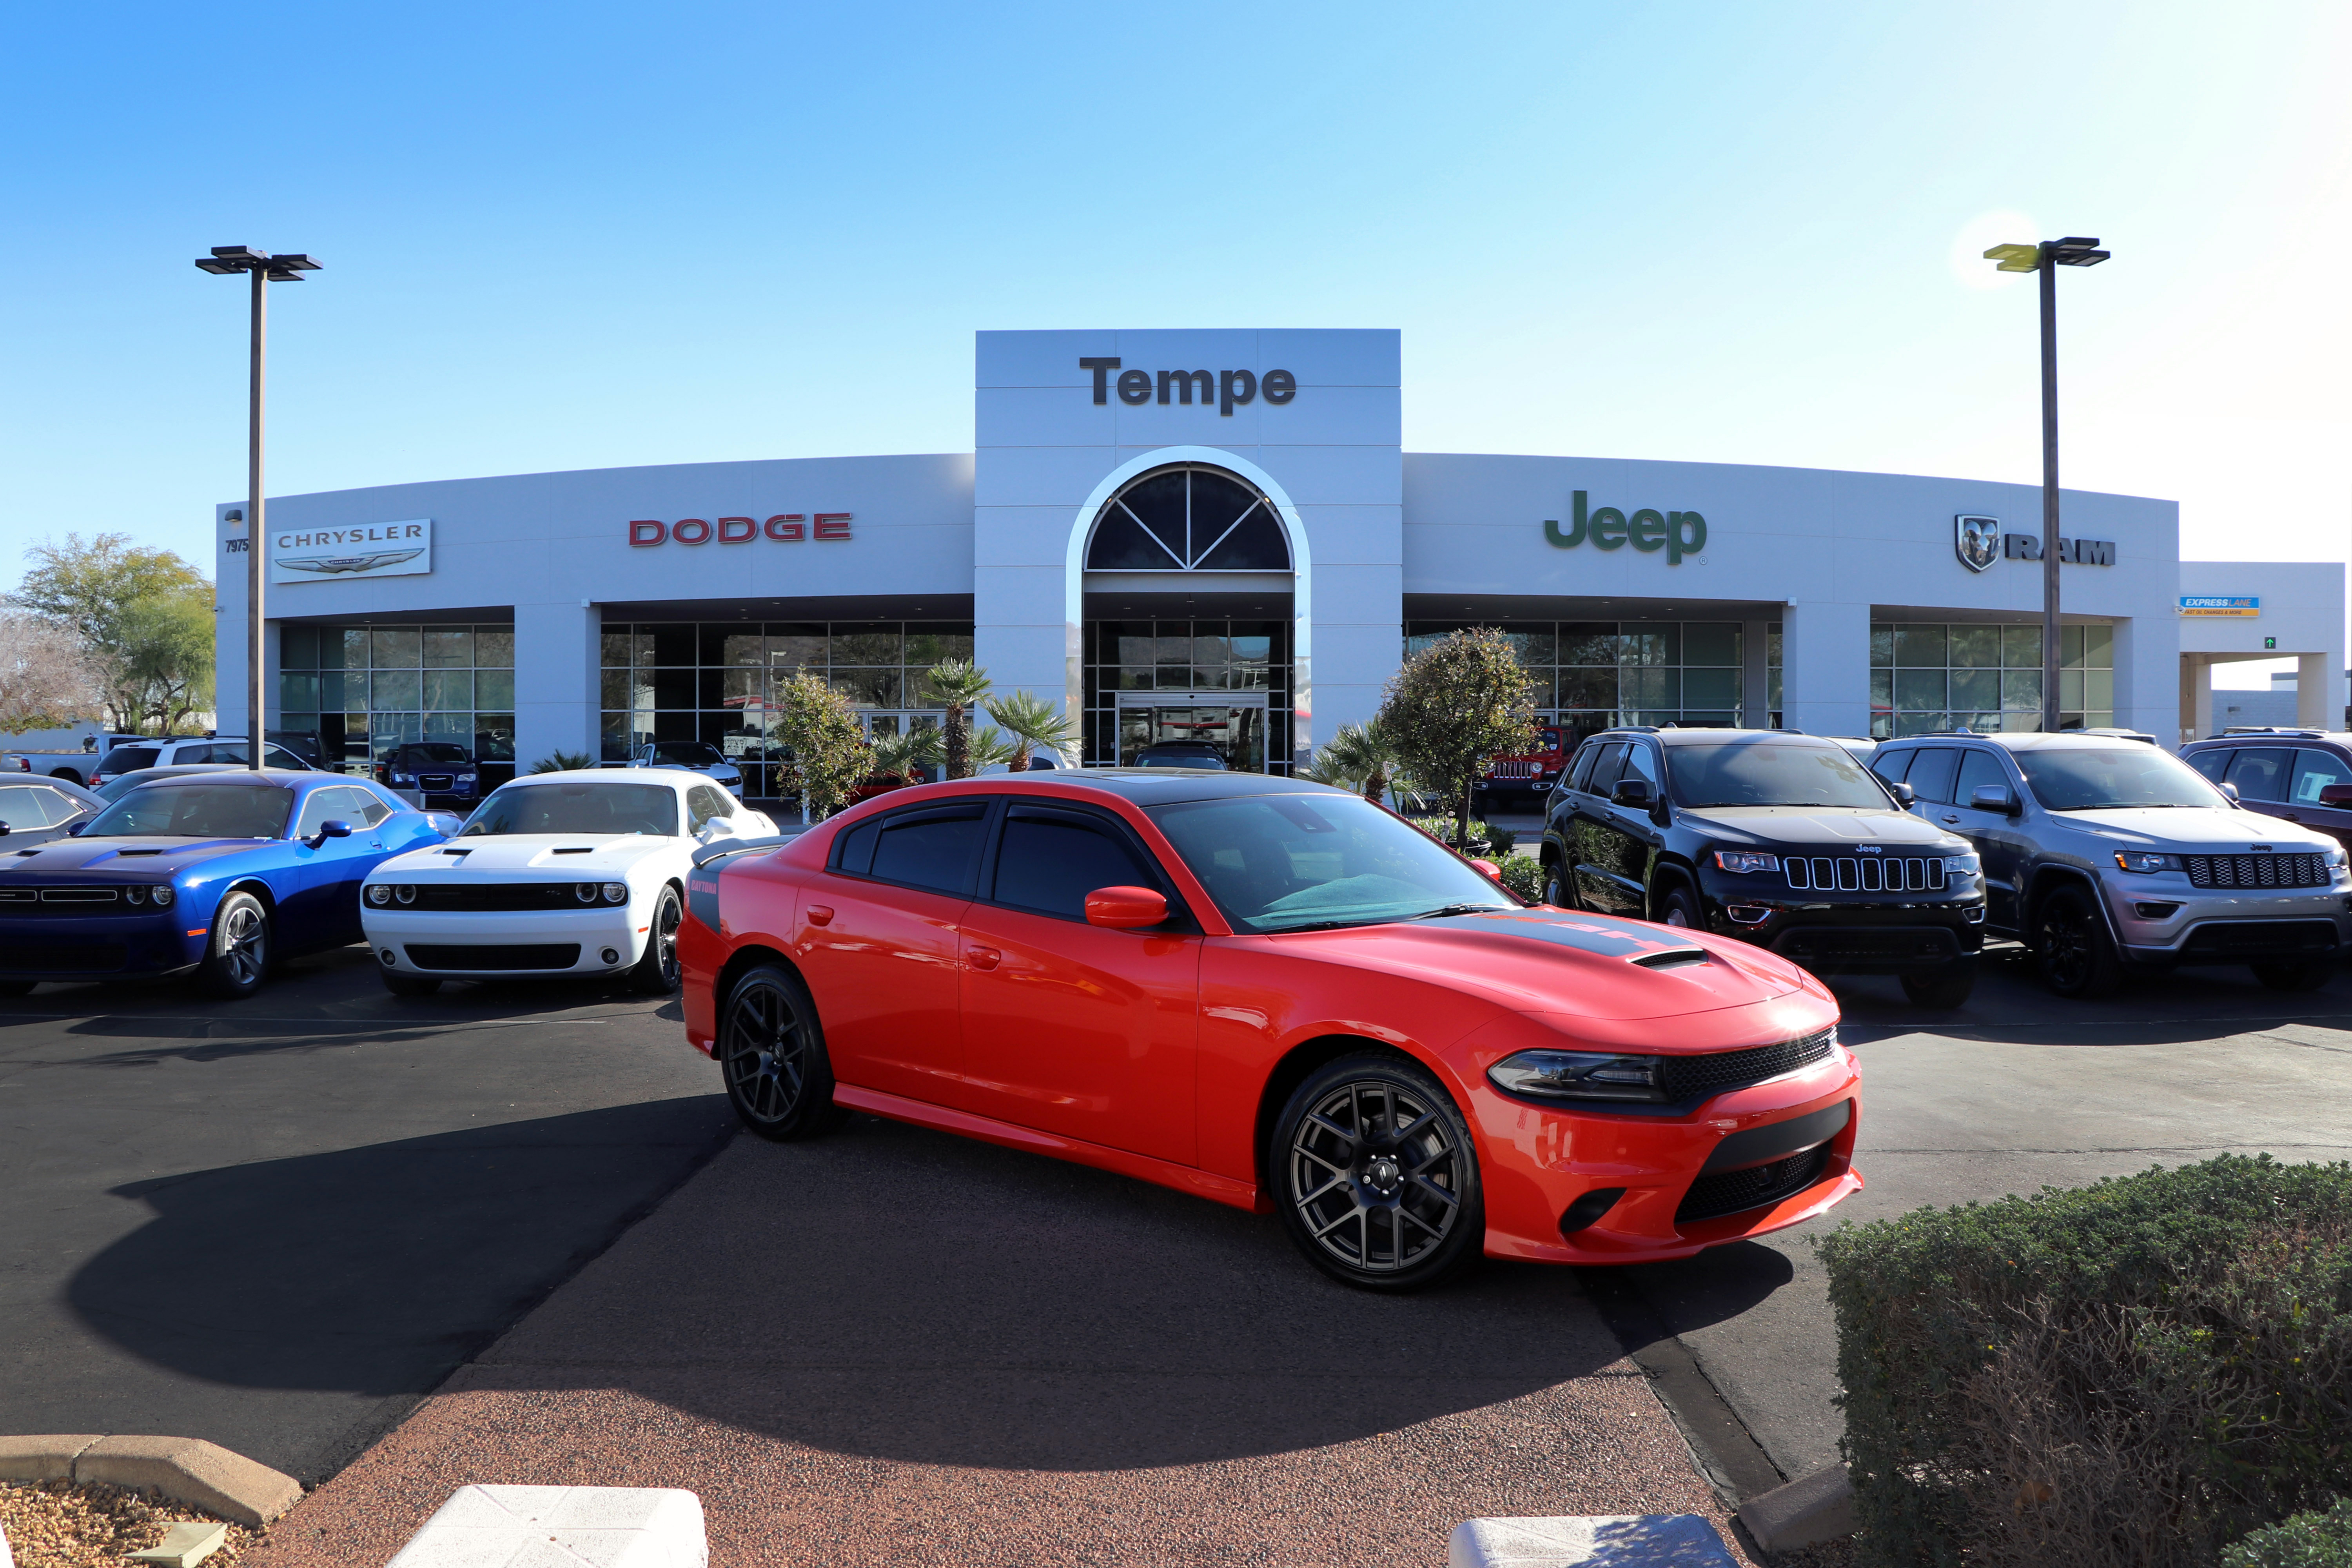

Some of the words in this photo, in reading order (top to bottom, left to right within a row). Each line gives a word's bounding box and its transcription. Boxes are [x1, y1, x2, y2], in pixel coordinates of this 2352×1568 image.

[1079, 357, 1296, 416] Tempe
[278, 524, 423, 548] CHRYSLER
[629, 512, 853, 546] DODGE
[1543, 490, 1707, 564] Jeep
[225, 538, 249, 553] 7975
[1855, 844, 1882, 854] Jeep
[2250, 843, 2272, 852] Jeep
[691, 880, 717, 895] DAYTONA
